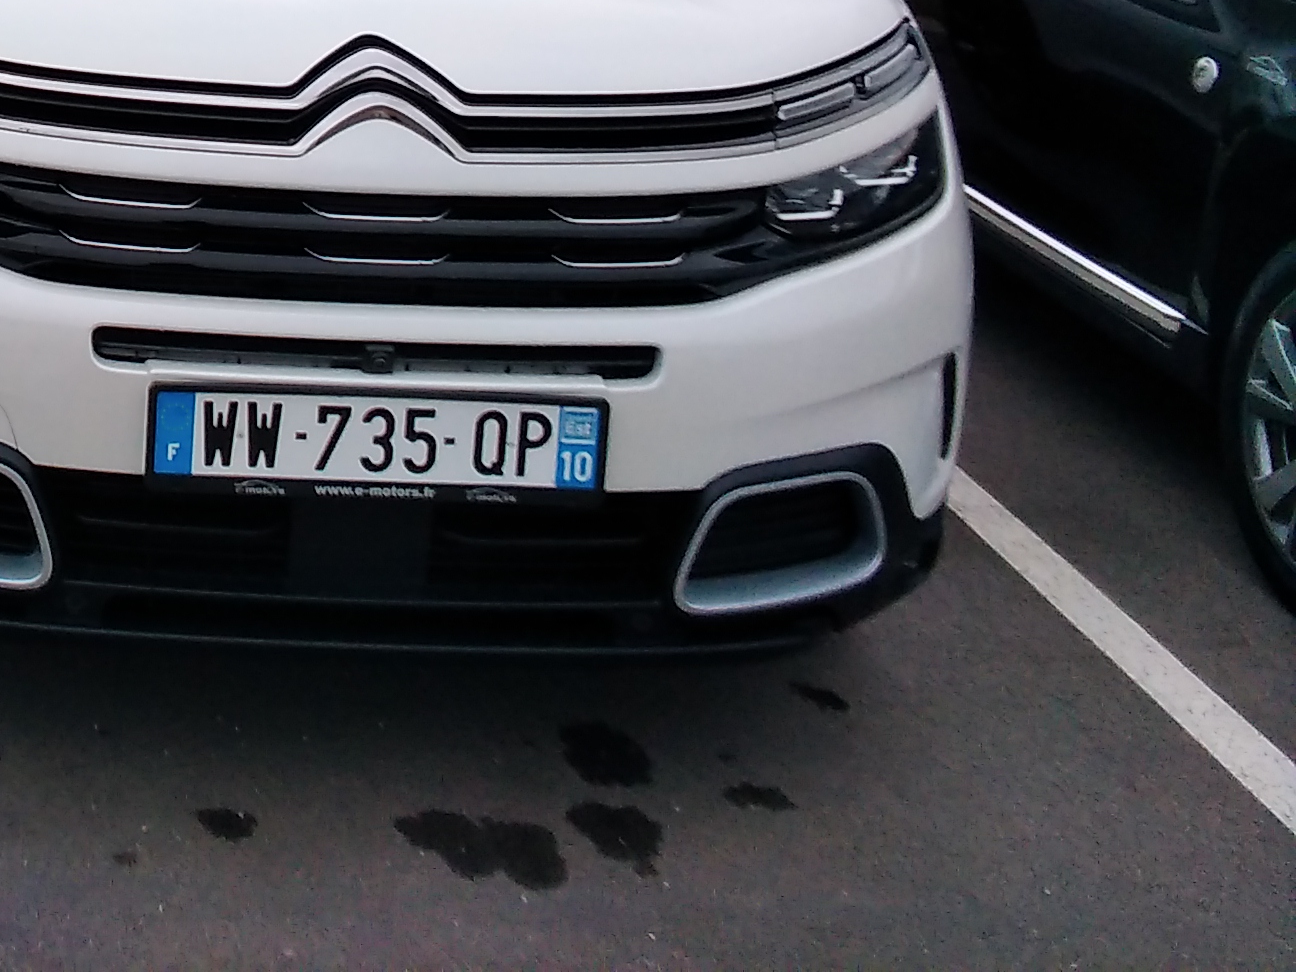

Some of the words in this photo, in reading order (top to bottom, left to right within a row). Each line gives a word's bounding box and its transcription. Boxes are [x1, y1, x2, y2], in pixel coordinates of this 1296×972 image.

[166, 442, 180, 461] F
[560, 450, 593, 482] 10
[314, 483, 436, 499] www.e-motors.fr
